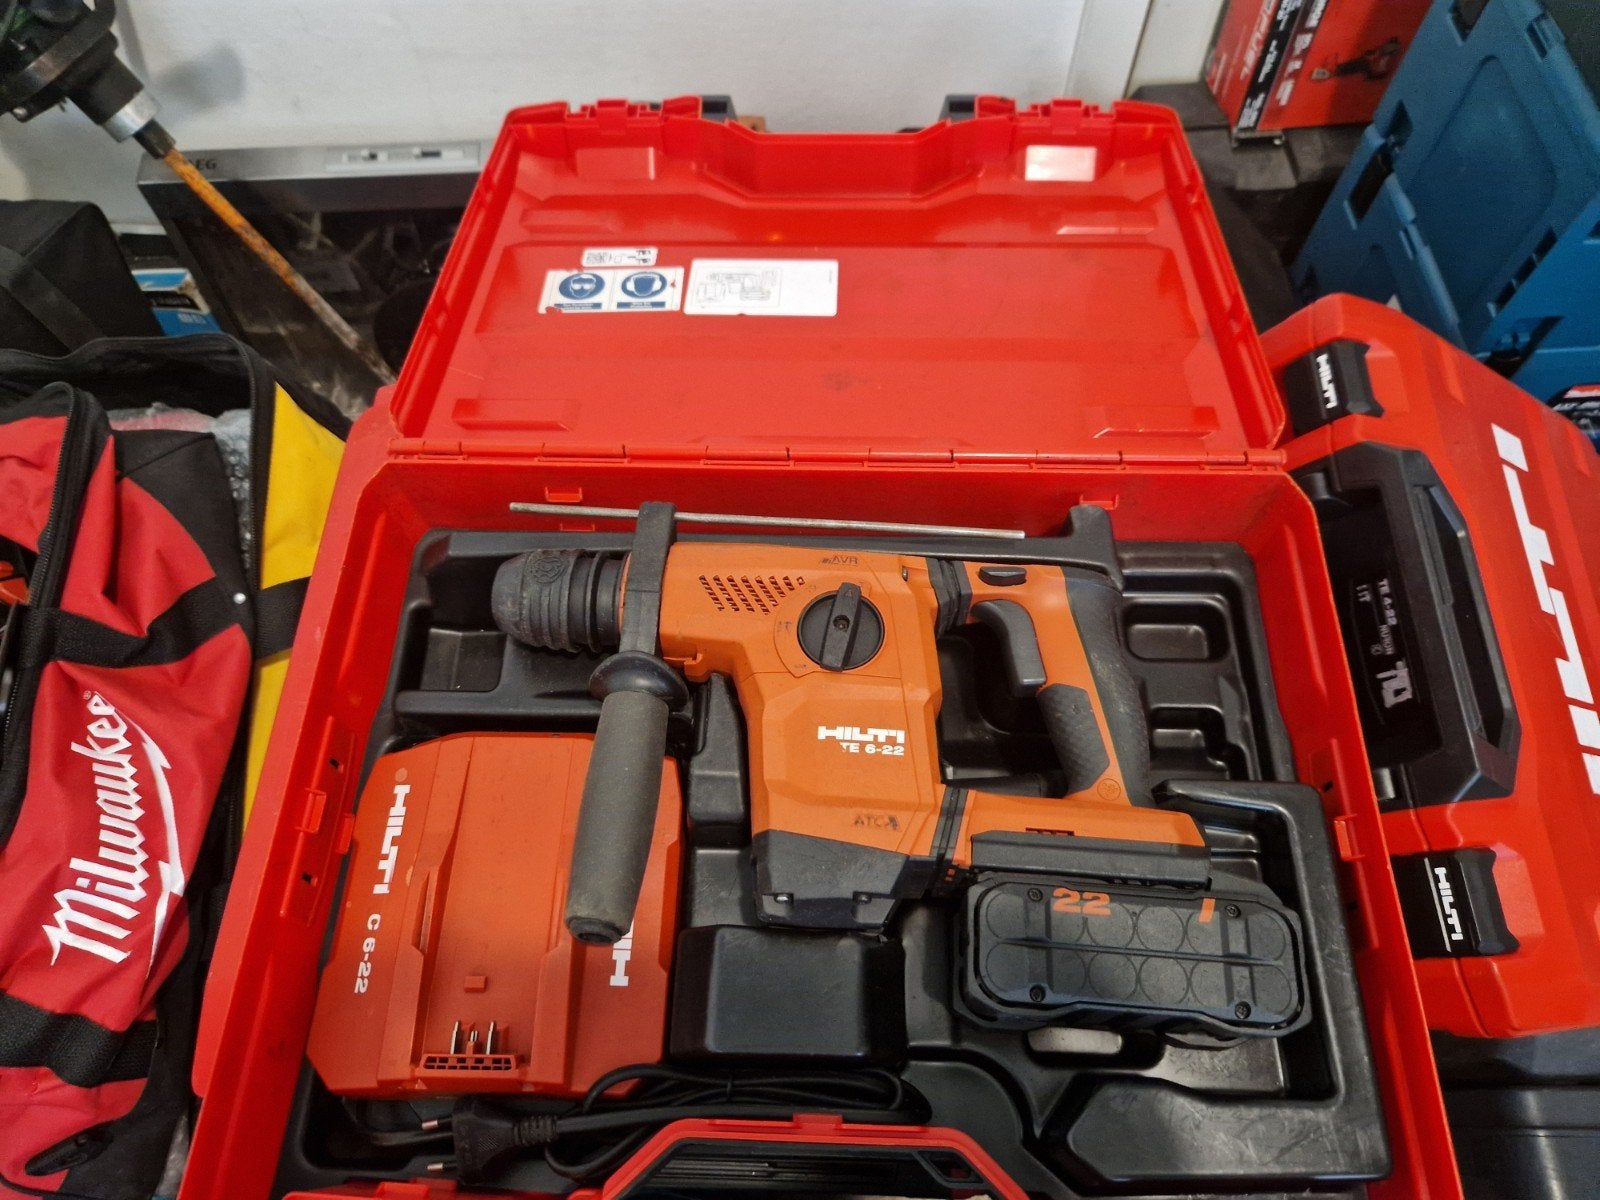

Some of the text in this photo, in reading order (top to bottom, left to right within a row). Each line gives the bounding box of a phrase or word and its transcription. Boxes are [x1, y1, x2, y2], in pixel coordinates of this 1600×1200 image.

[1316, 353, 1338, 409] HILTI
[830, 555, 858, 565] AVR
[1491, 423, 1600, 795] ILTI
[817, 725, 905, 744] HILTI
[839, 741, 905, 756] TE 6-22
[42, 691, 149, 967] Milwaukee
[373, 785, 411, 895] HILTI
[1052, 887, 1111, 916] 22
[1434, 867, 1463, 941] HILTI
[354, 914, 381, 994] C 6-22
